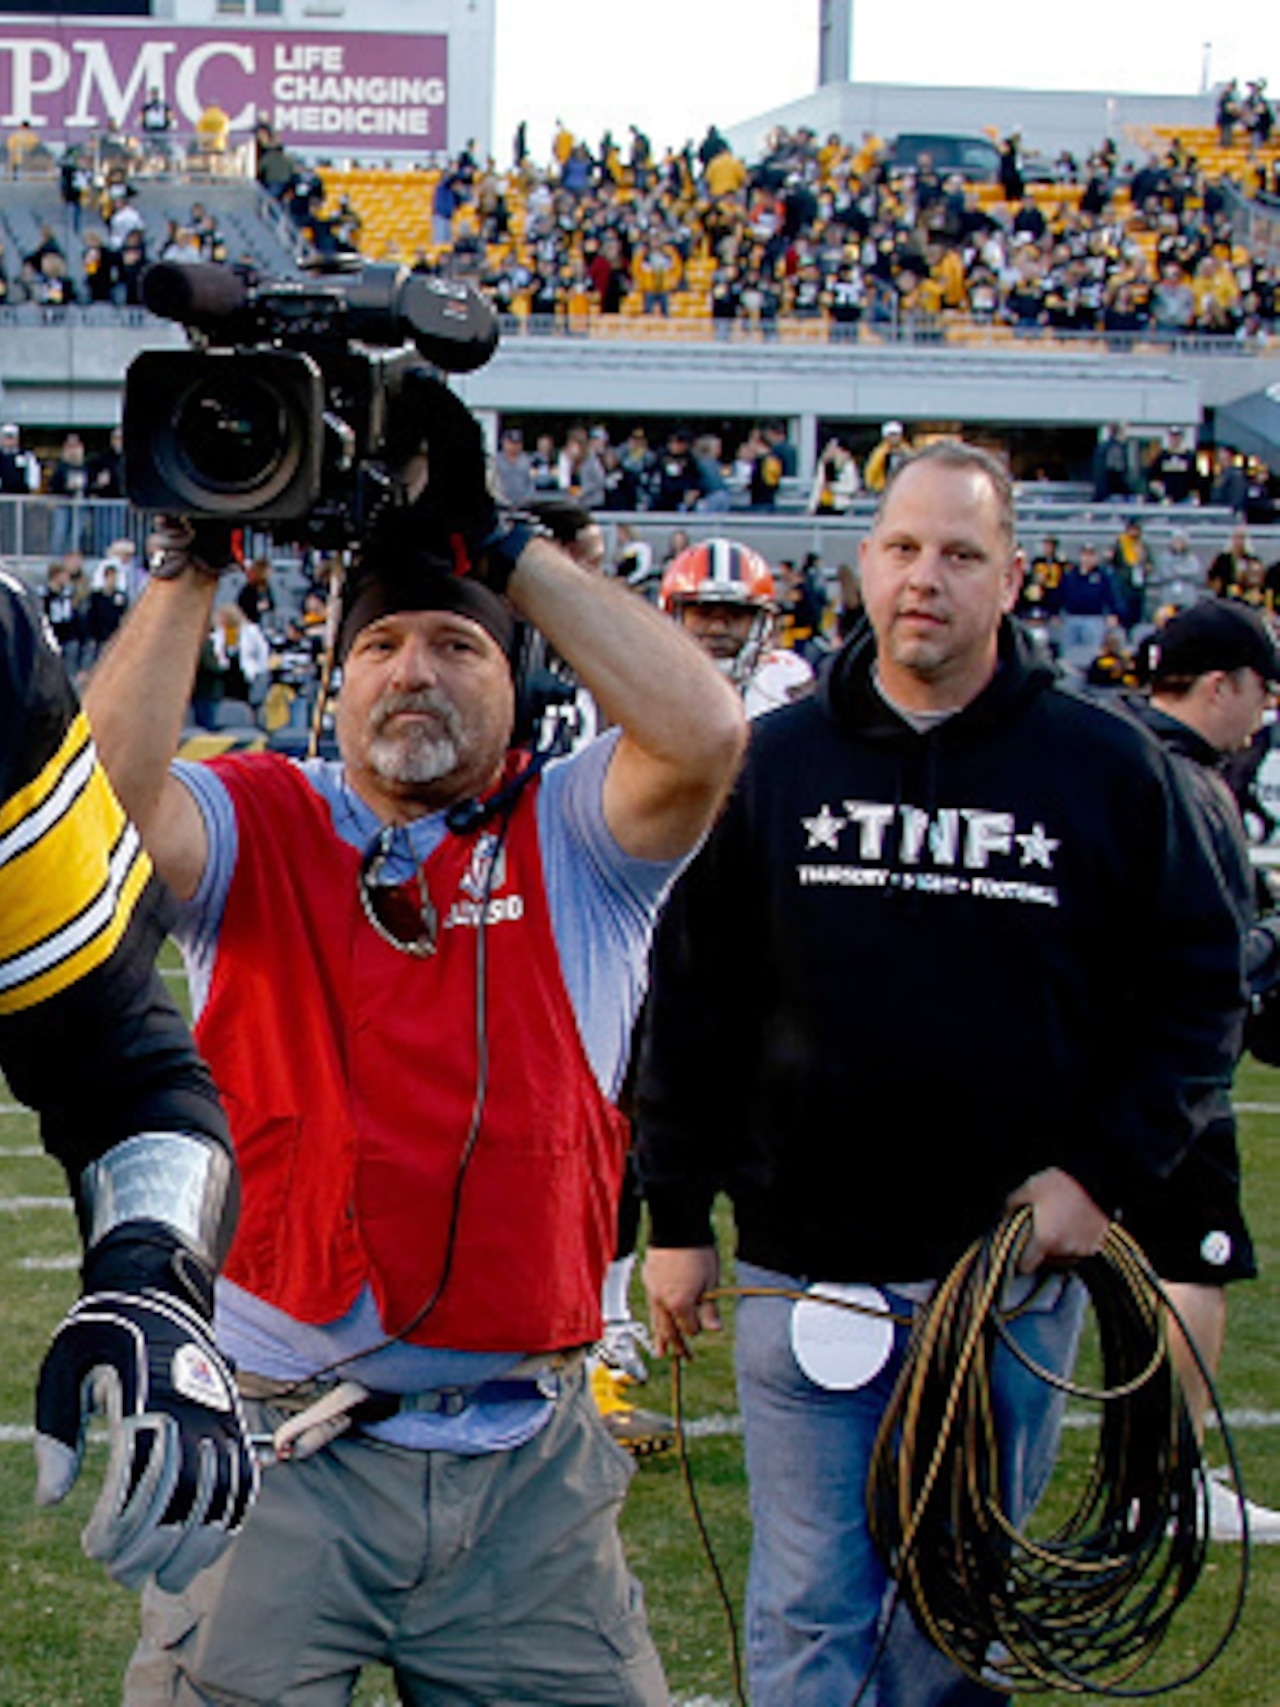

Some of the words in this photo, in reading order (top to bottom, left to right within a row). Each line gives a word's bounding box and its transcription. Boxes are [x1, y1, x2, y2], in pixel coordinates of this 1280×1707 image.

[274, 44, 344, 72] LIFE
[273, 74, 446, 105] CHANGING
[274, 105, 429, 135] MEDICINE
[842, 800, 1015, 869] TNF
